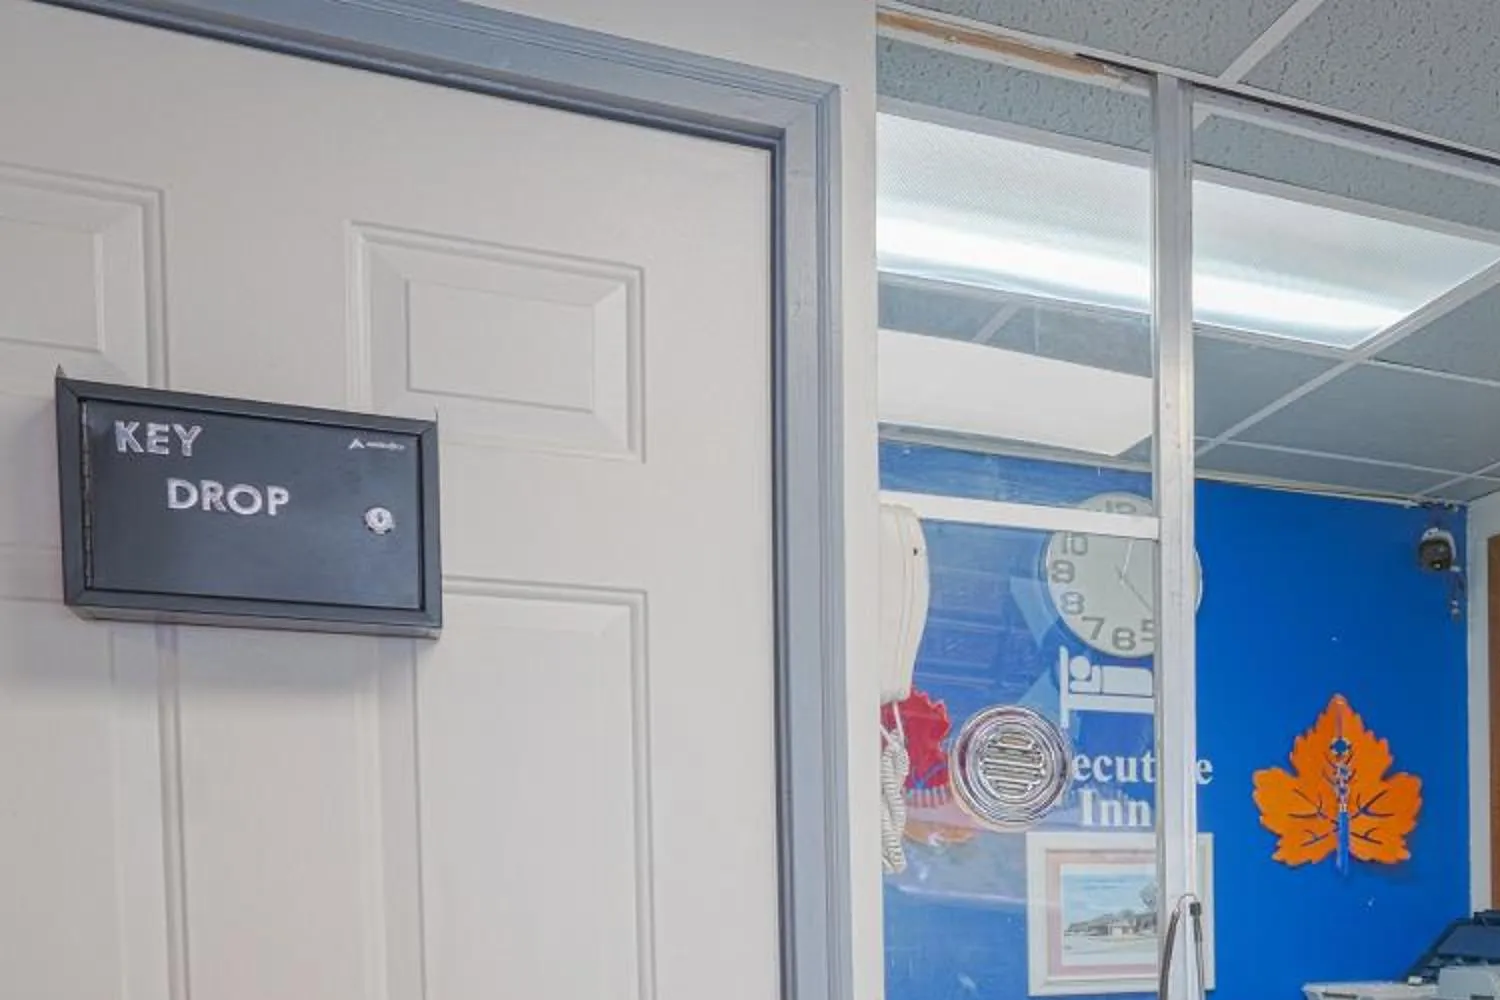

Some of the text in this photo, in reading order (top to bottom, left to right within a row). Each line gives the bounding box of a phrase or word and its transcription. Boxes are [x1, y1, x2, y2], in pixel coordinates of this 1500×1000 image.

[114, 420, 202, 457] KEY
[167, 477, 290, 516] DROP
[1060, 591, 1085, 615] 8
[1082, 616, 1105, 640] 7
[1112, 627, 1136, 651] 6
[1072, 750, 1214, 785] ecute
[1079, 786, 1153, 828] Inn
